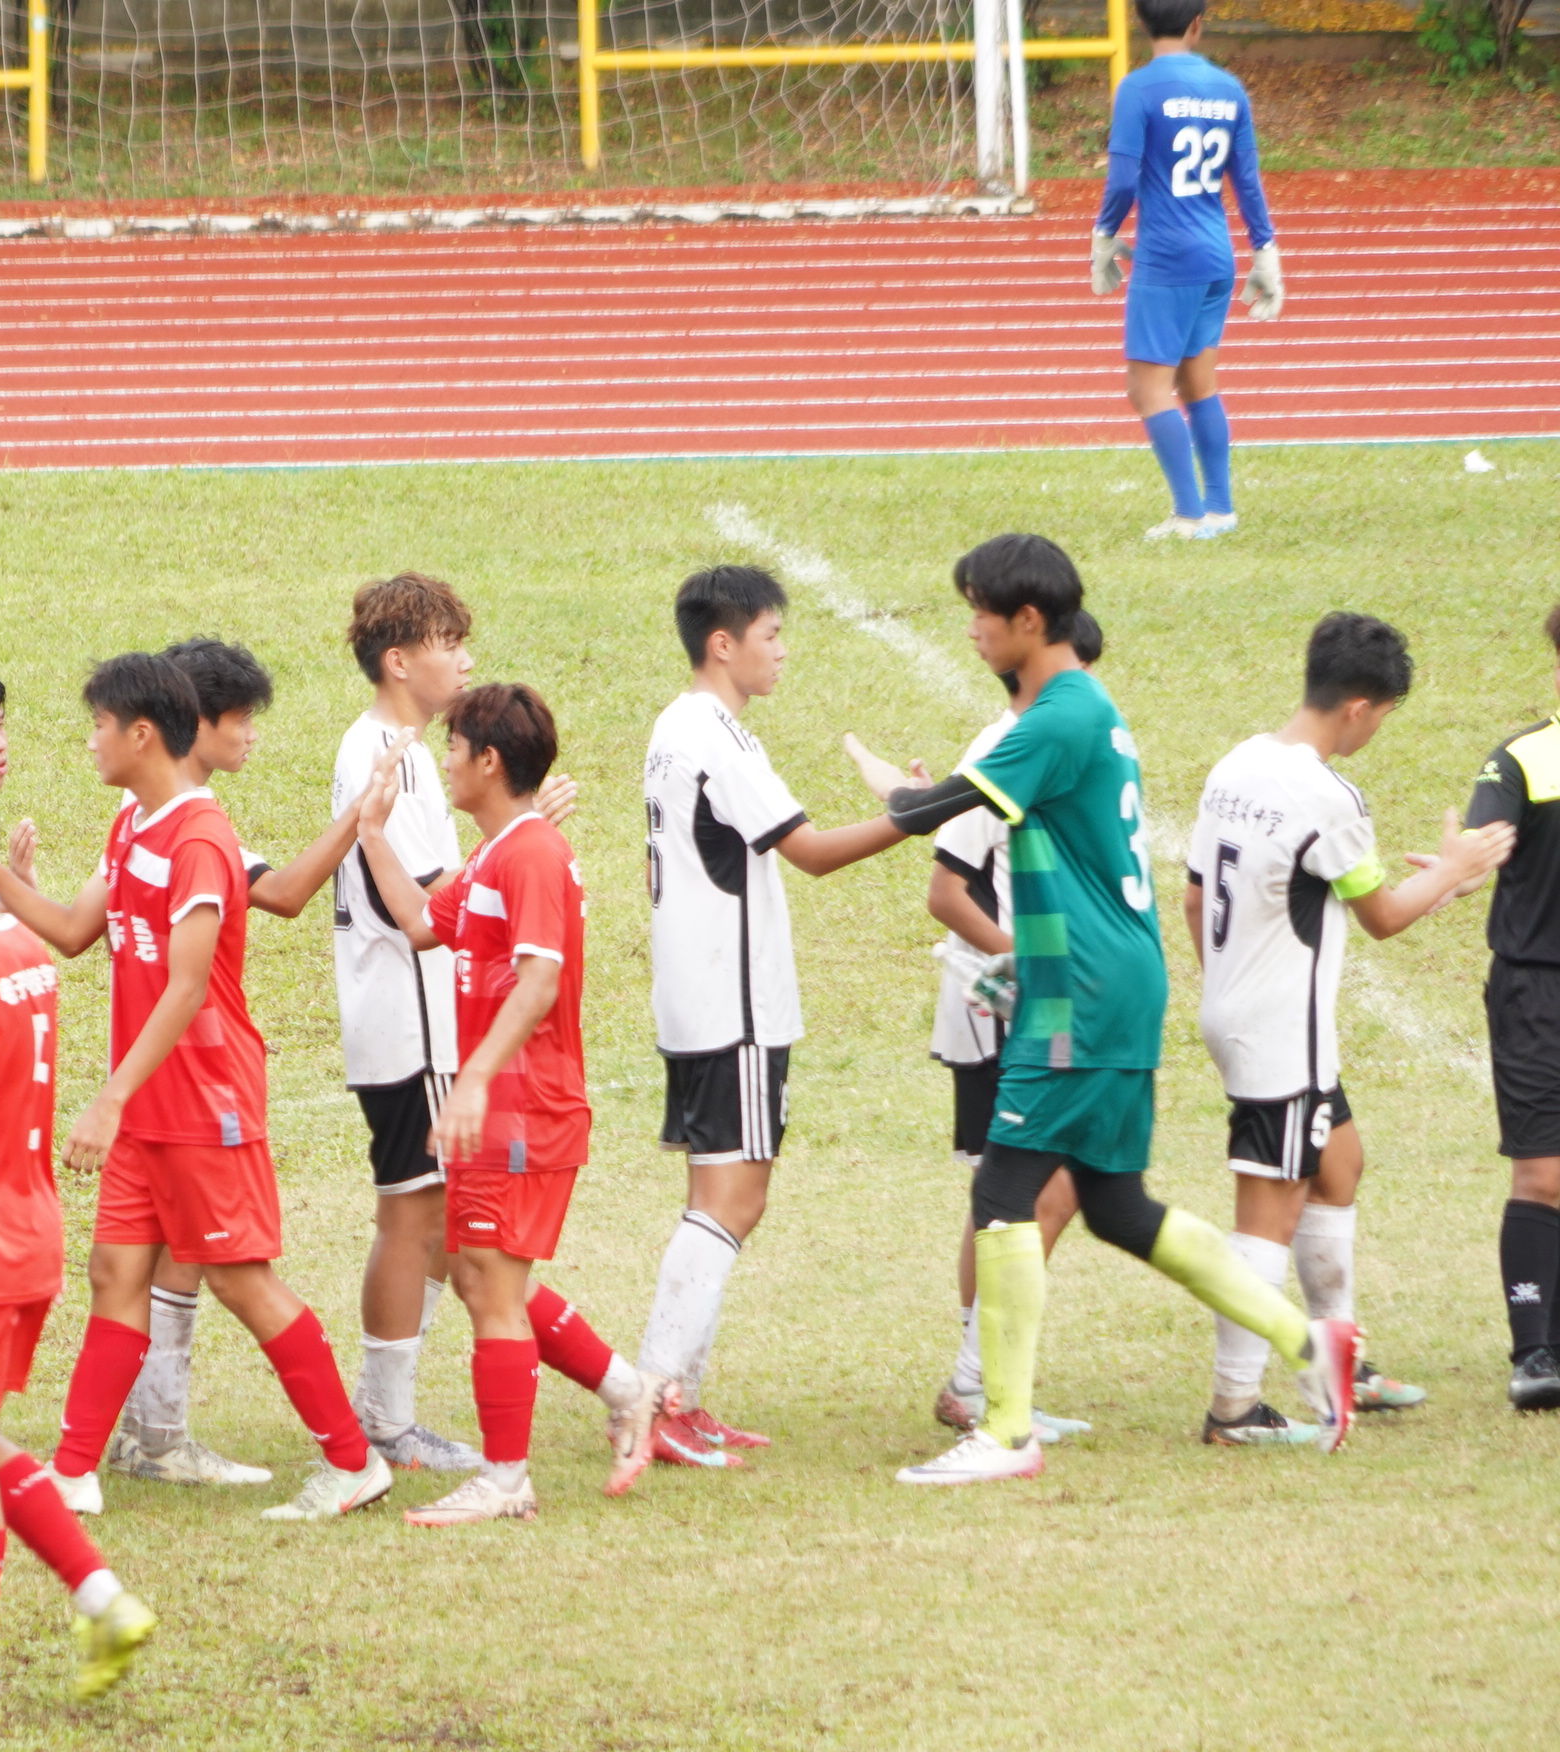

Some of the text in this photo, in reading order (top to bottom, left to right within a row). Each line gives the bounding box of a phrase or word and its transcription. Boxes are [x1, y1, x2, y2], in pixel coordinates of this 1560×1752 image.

[1171, 125, 1230, 197] 22
[1210, 837, 1242, 953] 5
[1309, 1101, 1333, 1150] 5
[468, 1220, 497, 1231] LOOKS
